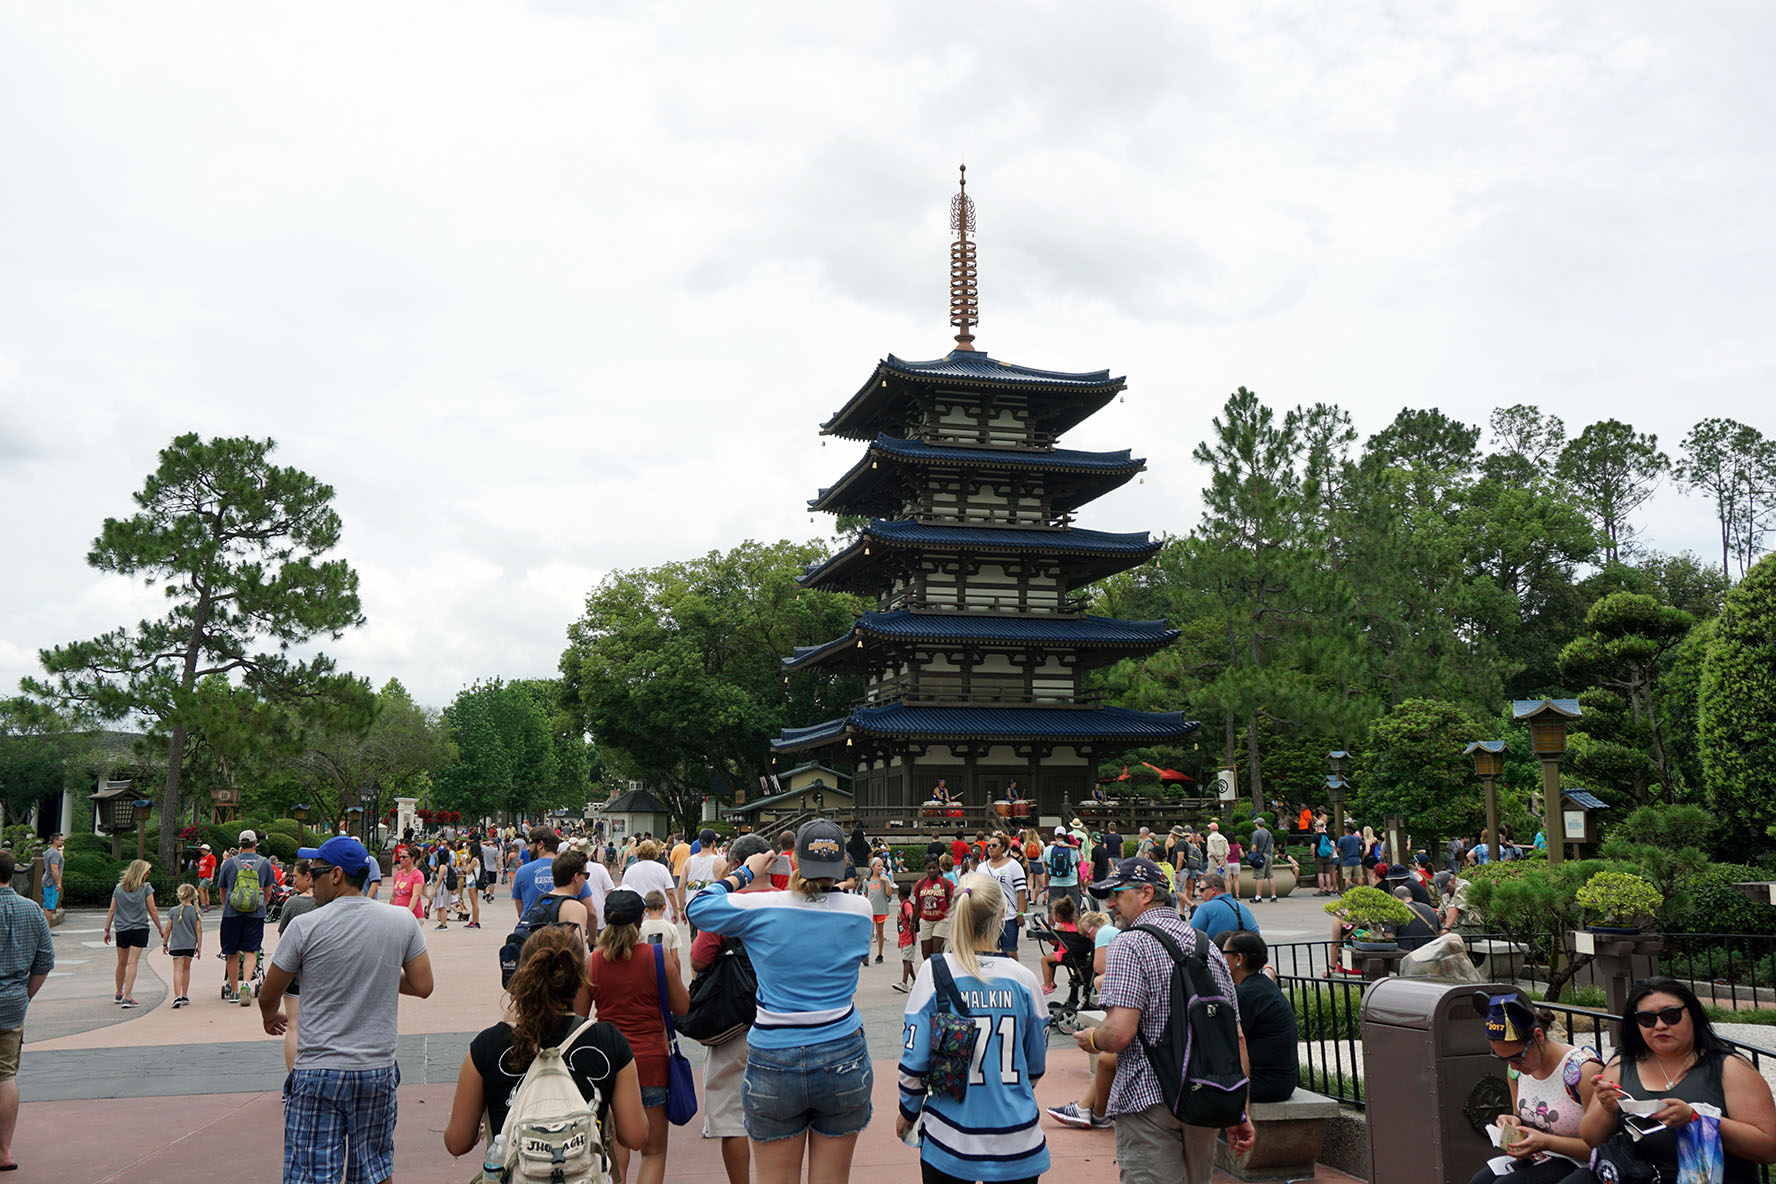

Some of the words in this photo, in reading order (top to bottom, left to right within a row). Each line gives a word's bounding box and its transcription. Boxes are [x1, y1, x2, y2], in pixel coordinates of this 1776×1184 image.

[537, 876, 554, 884] FINA
[961, 990, 1012, 1009] MALKIN
[903, 1021, 917, 1050] 1
[1489, 1023, 1505, 1031] 2017
[969, 1015, 1020, 1085] 71
